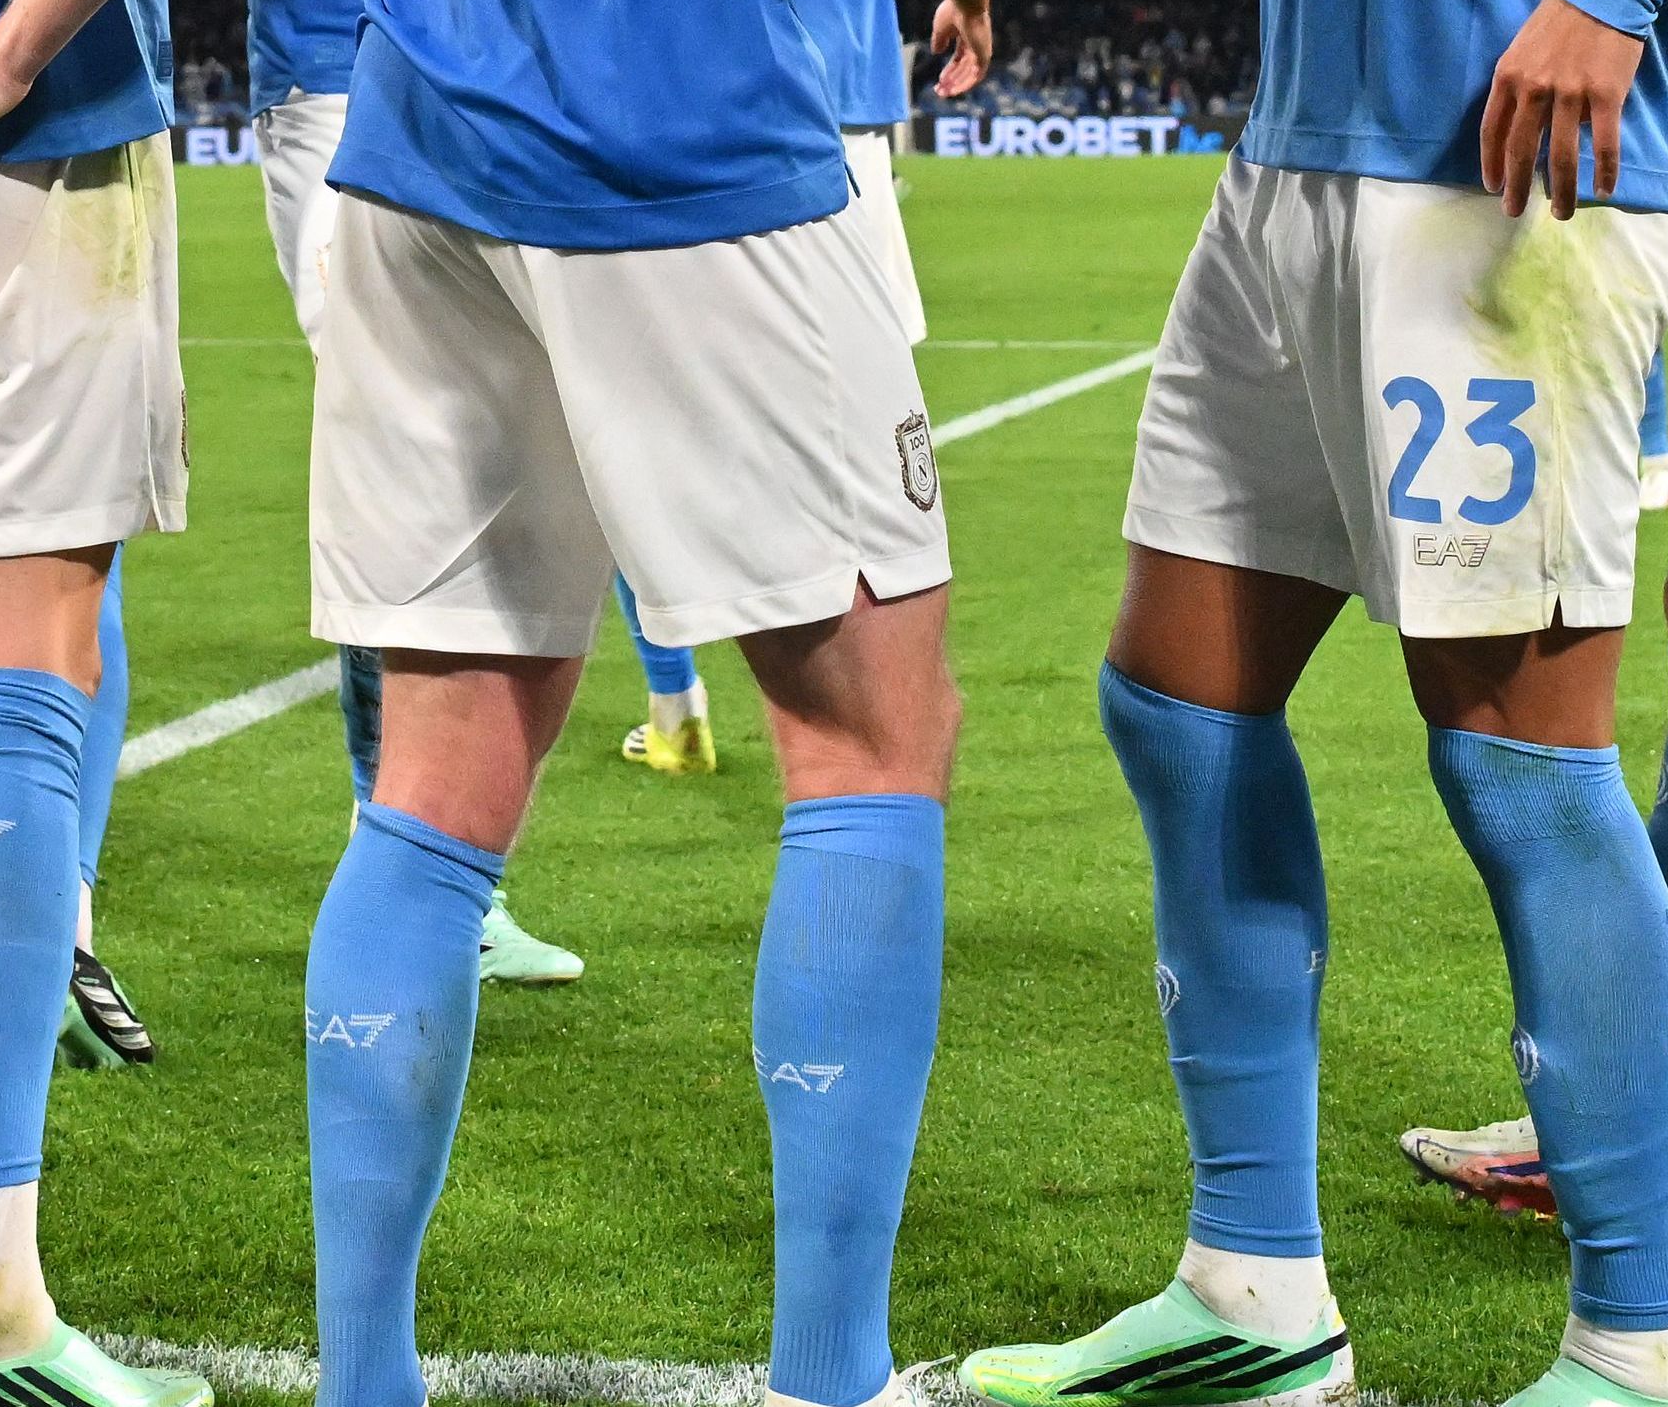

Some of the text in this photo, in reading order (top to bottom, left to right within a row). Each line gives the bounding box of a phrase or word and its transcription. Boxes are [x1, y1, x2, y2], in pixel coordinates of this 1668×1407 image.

[934, 115, 1179, 156] EUROBET
[909, 433, 925, 451] 100
[1382, 375, 1536, 526] 23
[1413, 532, 1491, 568] EA7
[305, 1005, 396, 1048] EA7
[753, 1046, 845, 1094] EA7
